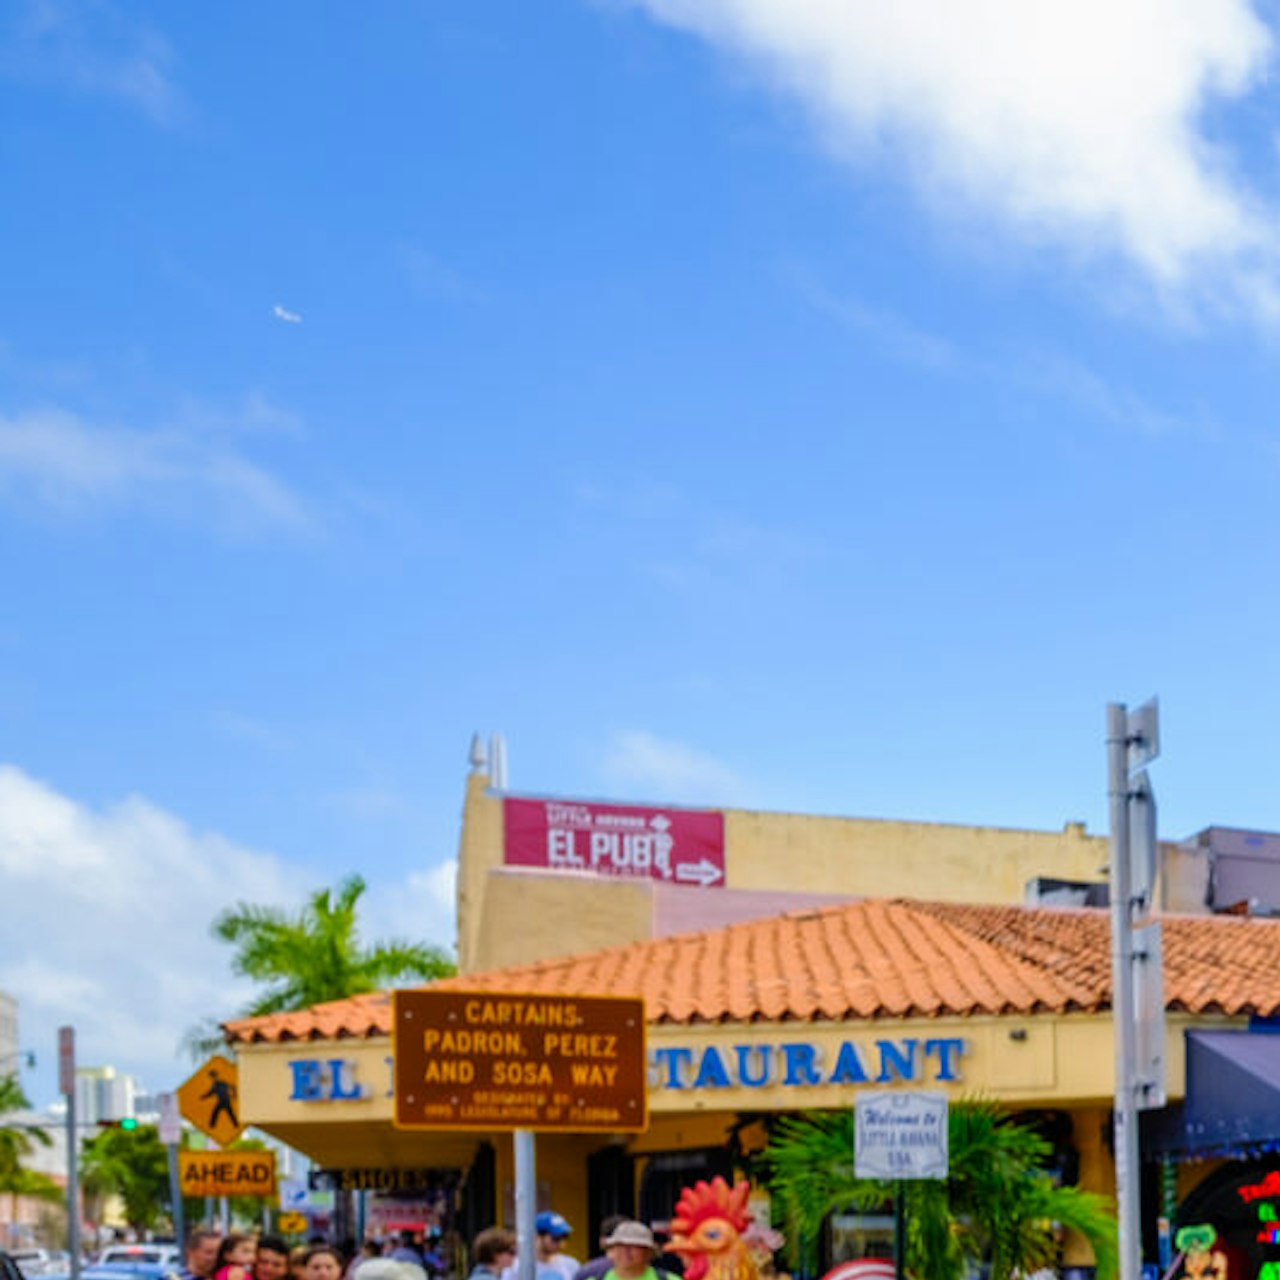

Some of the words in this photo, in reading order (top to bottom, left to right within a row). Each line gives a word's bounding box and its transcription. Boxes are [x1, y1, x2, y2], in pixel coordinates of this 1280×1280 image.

[547, 828, 585, 865] EL
[590, 832, 650, 867] PUB
[543, 1033, 618, 1058] PEREZ
[288, 1058, 361, 1101] EL
[654, 1038, 966, 1089] TAURANT
[424, 1060, 475, 1084] AND
[492, 1062, 554, 1085] SOSA
[570, 1063, 619, 1086] WAY
[184, 1162, 270, 1184] AHEAD
